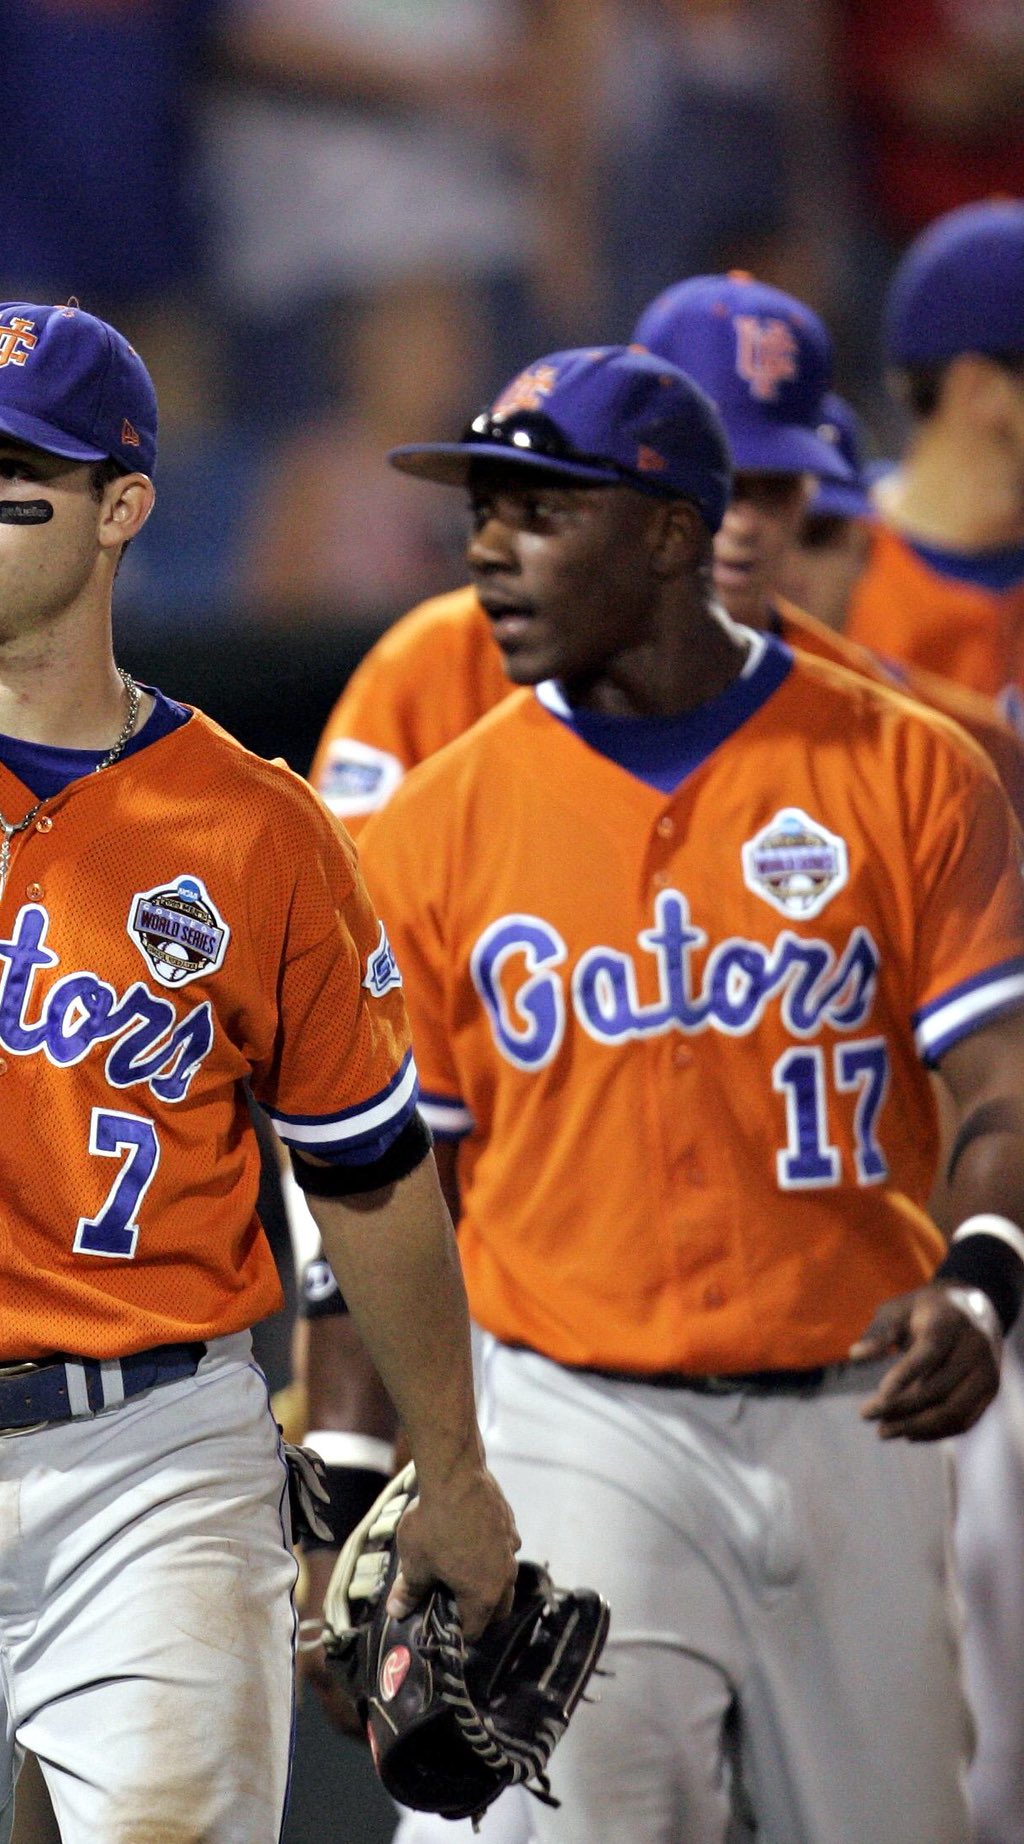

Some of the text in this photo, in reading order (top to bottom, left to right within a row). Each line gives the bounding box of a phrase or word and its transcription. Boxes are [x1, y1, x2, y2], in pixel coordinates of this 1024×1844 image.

[141, 910, 216, 955] WORLD SERIES
[470, 888, 878, 1072] Gators
[73, 1106, 161, 1258] 7
[773, 1037, 890, 1190] 17
